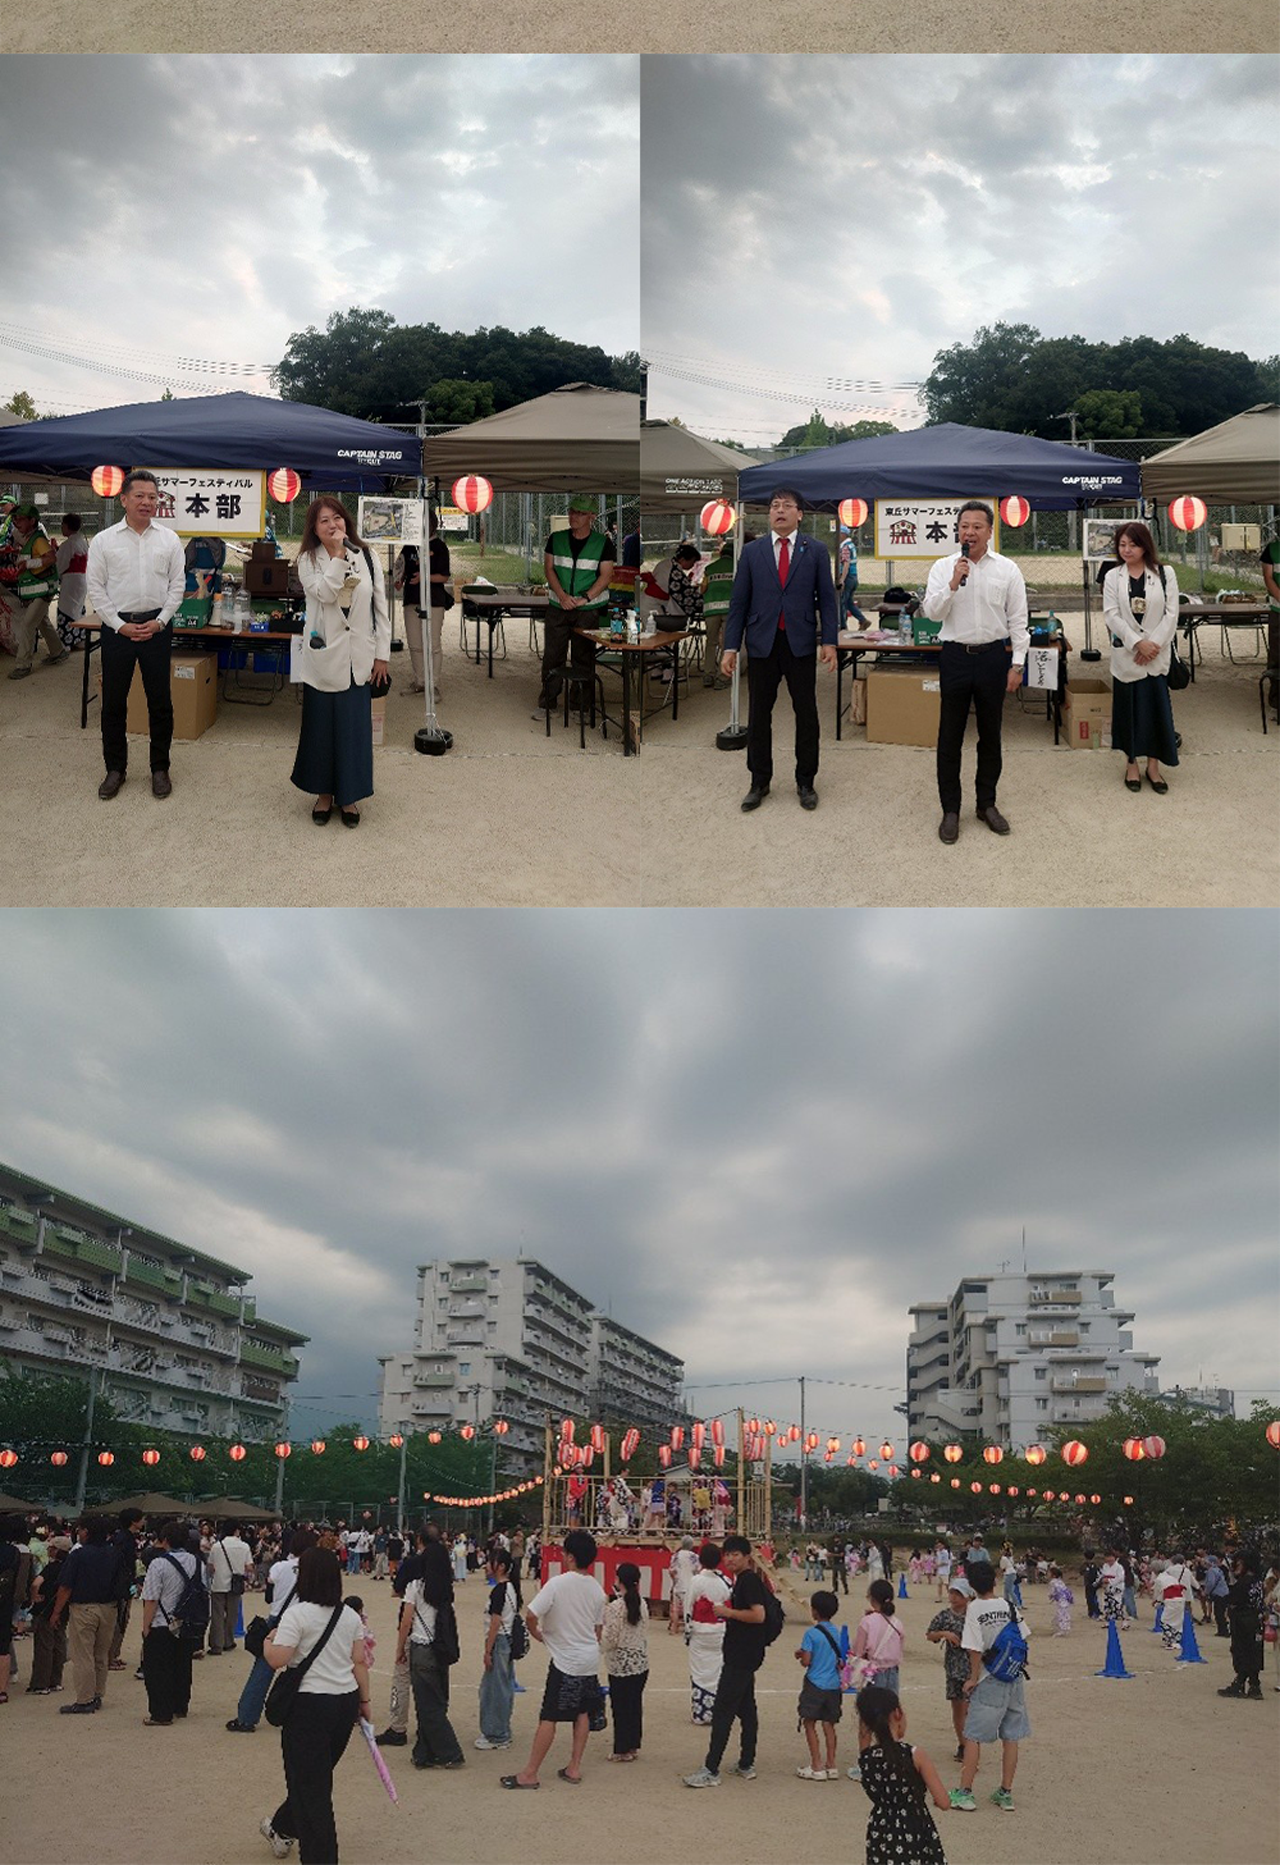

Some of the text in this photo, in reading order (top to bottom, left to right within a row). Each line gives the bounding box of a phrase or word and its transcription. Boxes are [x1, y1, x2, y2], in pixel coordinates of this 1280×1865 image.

[337, 449, 403, 460] CAPTAIN STAG
[155, 477, 253, 488] 丘サマーフェスティバル
[1062, 476, 1123, 484] CAPTAIN STAG
[185, 493, 241, 519] 本部
